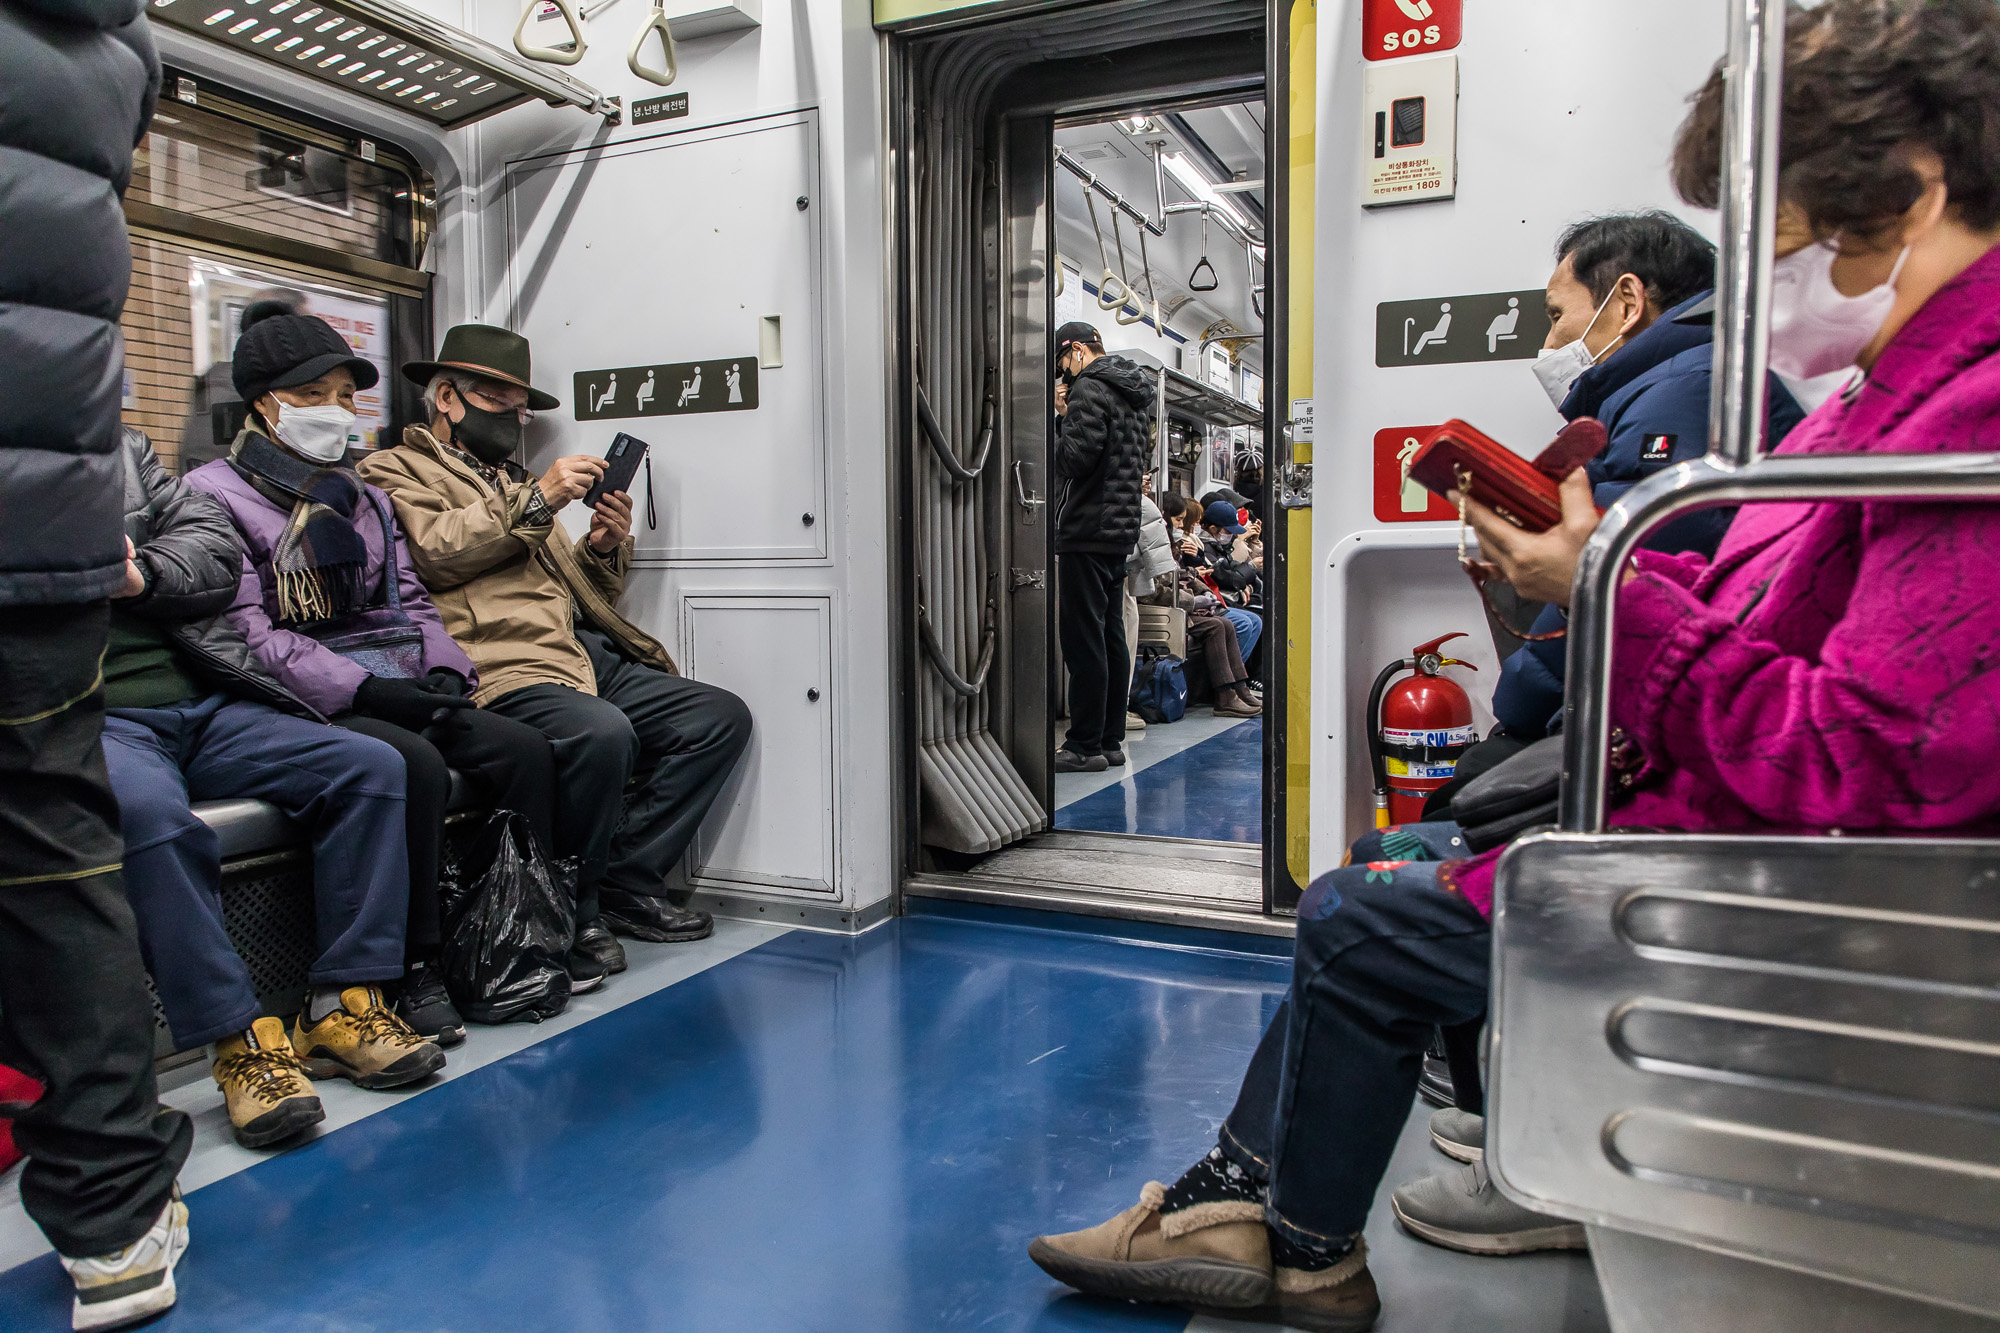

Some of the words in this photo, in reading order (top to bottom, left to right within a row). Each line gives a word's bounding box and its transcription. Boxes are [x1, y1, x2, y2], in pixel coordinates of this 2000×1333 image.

[1383, 25, 1441, 51] SOS
[662, 99, 686, 111] 배전반
[1388, 159, 1429, 170] 비상통화장치
[1416, 179, 1441, 190] 1809
